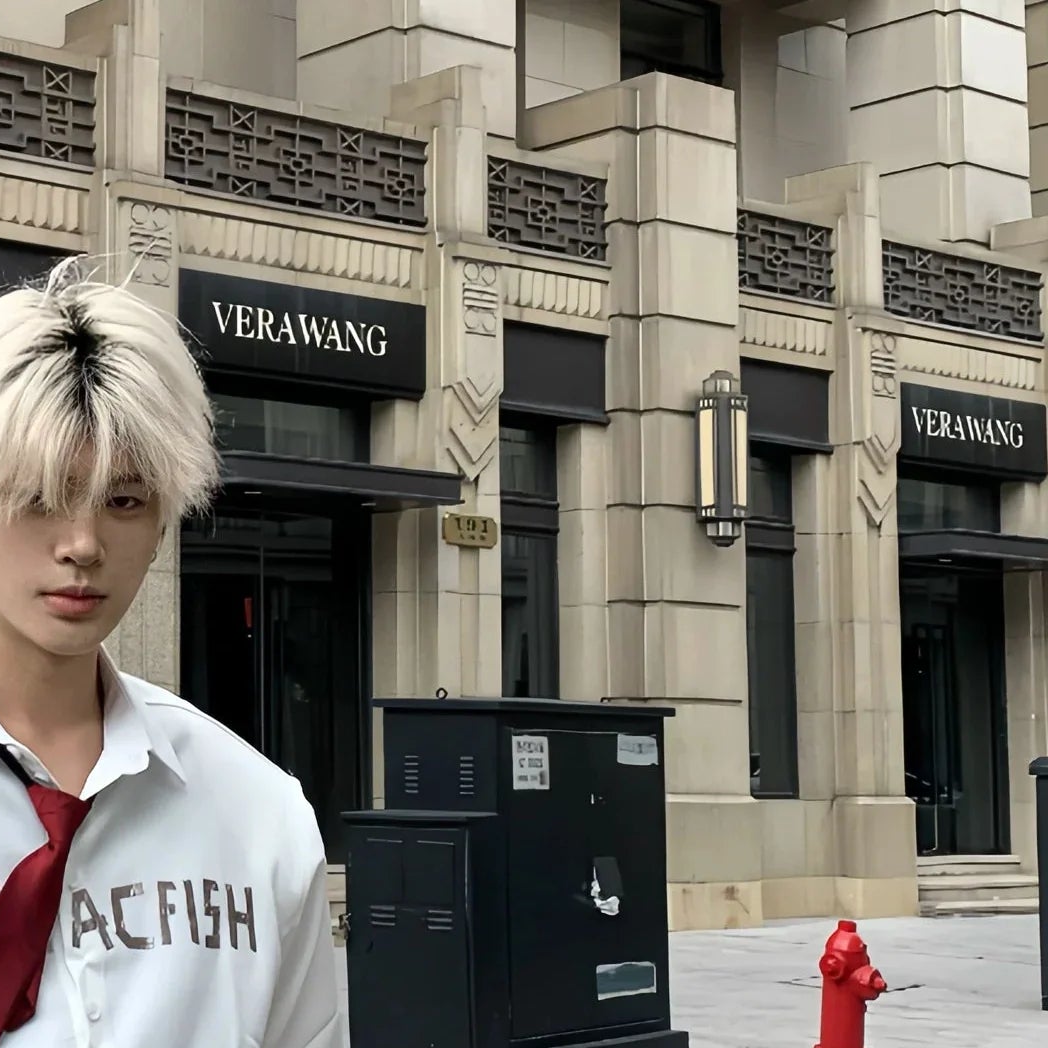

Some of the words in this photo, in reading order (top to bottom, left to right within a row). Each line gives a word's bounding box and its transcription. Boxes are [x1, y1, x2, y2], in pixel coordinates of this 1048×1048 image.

[212, 301, 297, 345] VERA
[298, 313, 388, 357] WANG
[911, 406, 966, 441] VERA
[966, 415, 1024, 449] WANG
